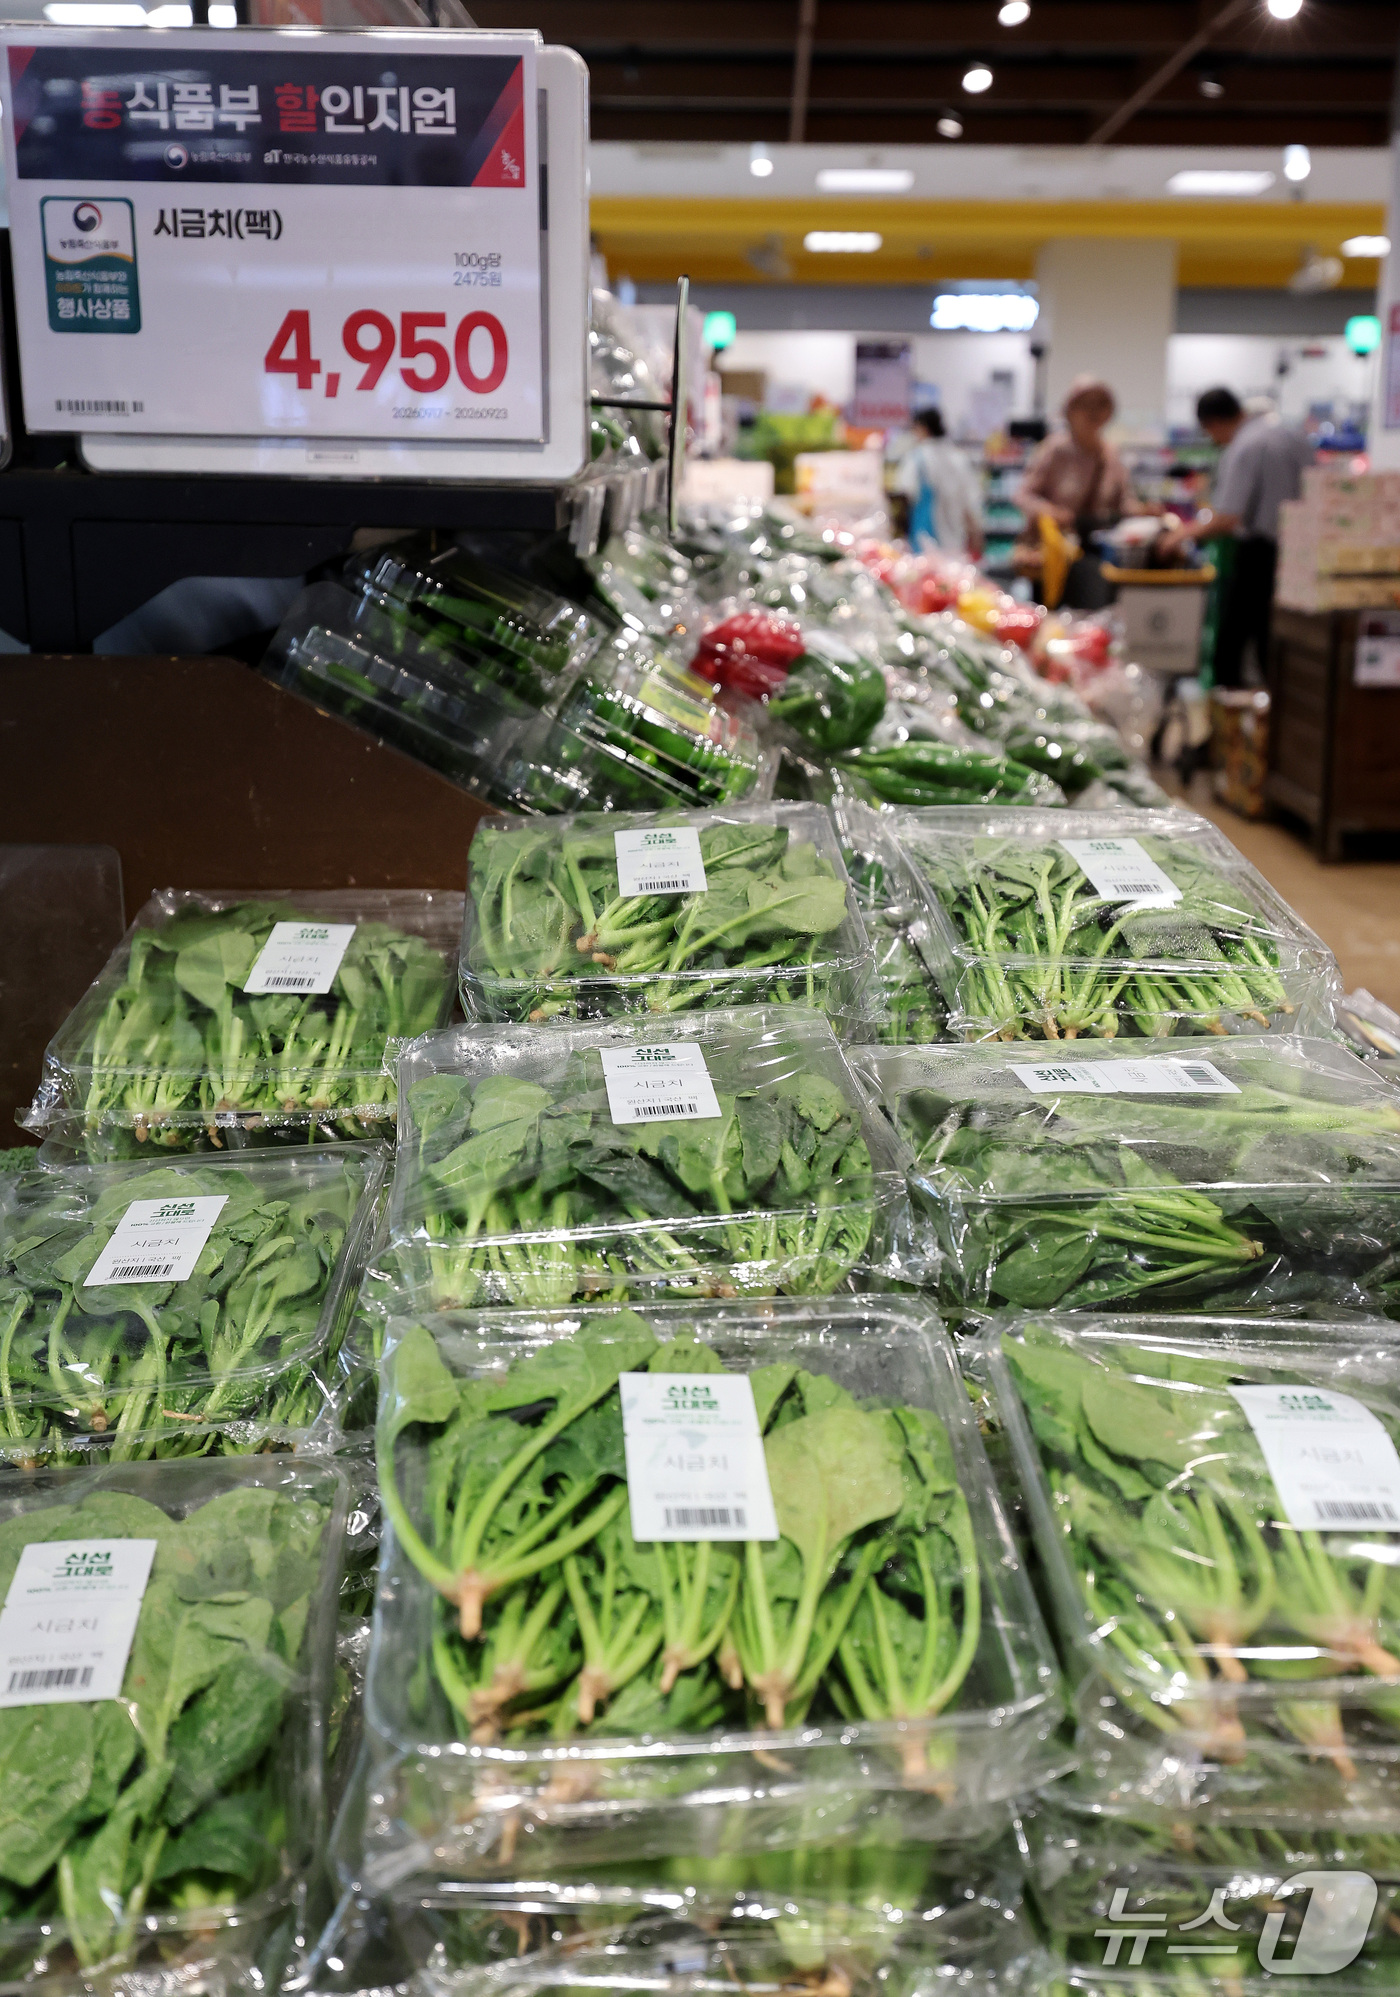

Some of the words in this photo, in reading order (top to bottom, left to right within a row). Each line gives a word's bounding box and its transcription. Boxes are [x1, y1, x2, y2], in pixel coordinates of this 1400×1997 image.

[81, 82, 262, 132] 농식품부
[273, 82, 458, 135] 할인지원
[153, 208, 283, 240] 시금치(팩)
[454, 252, 502, 270] 100g당
[453, 271, 502, 287] 2475원
[57, 297, 131, 319] 행사상품
[264, 308, 509, 398] 4,950
[453, 408, 509, 420] 20260923
[635, 1048, 671, 1056] 신선
[633, 1079, 683, 1089] 시금치
[160, 1202, 195, 1211] 신선
[150, 1209, 196, 1218] 그대로
[130, 1238, 181, 1248] 시금치
[65, 1552, 113, 1565] 신선
[52, 1565, 113, 1578] 그대로
